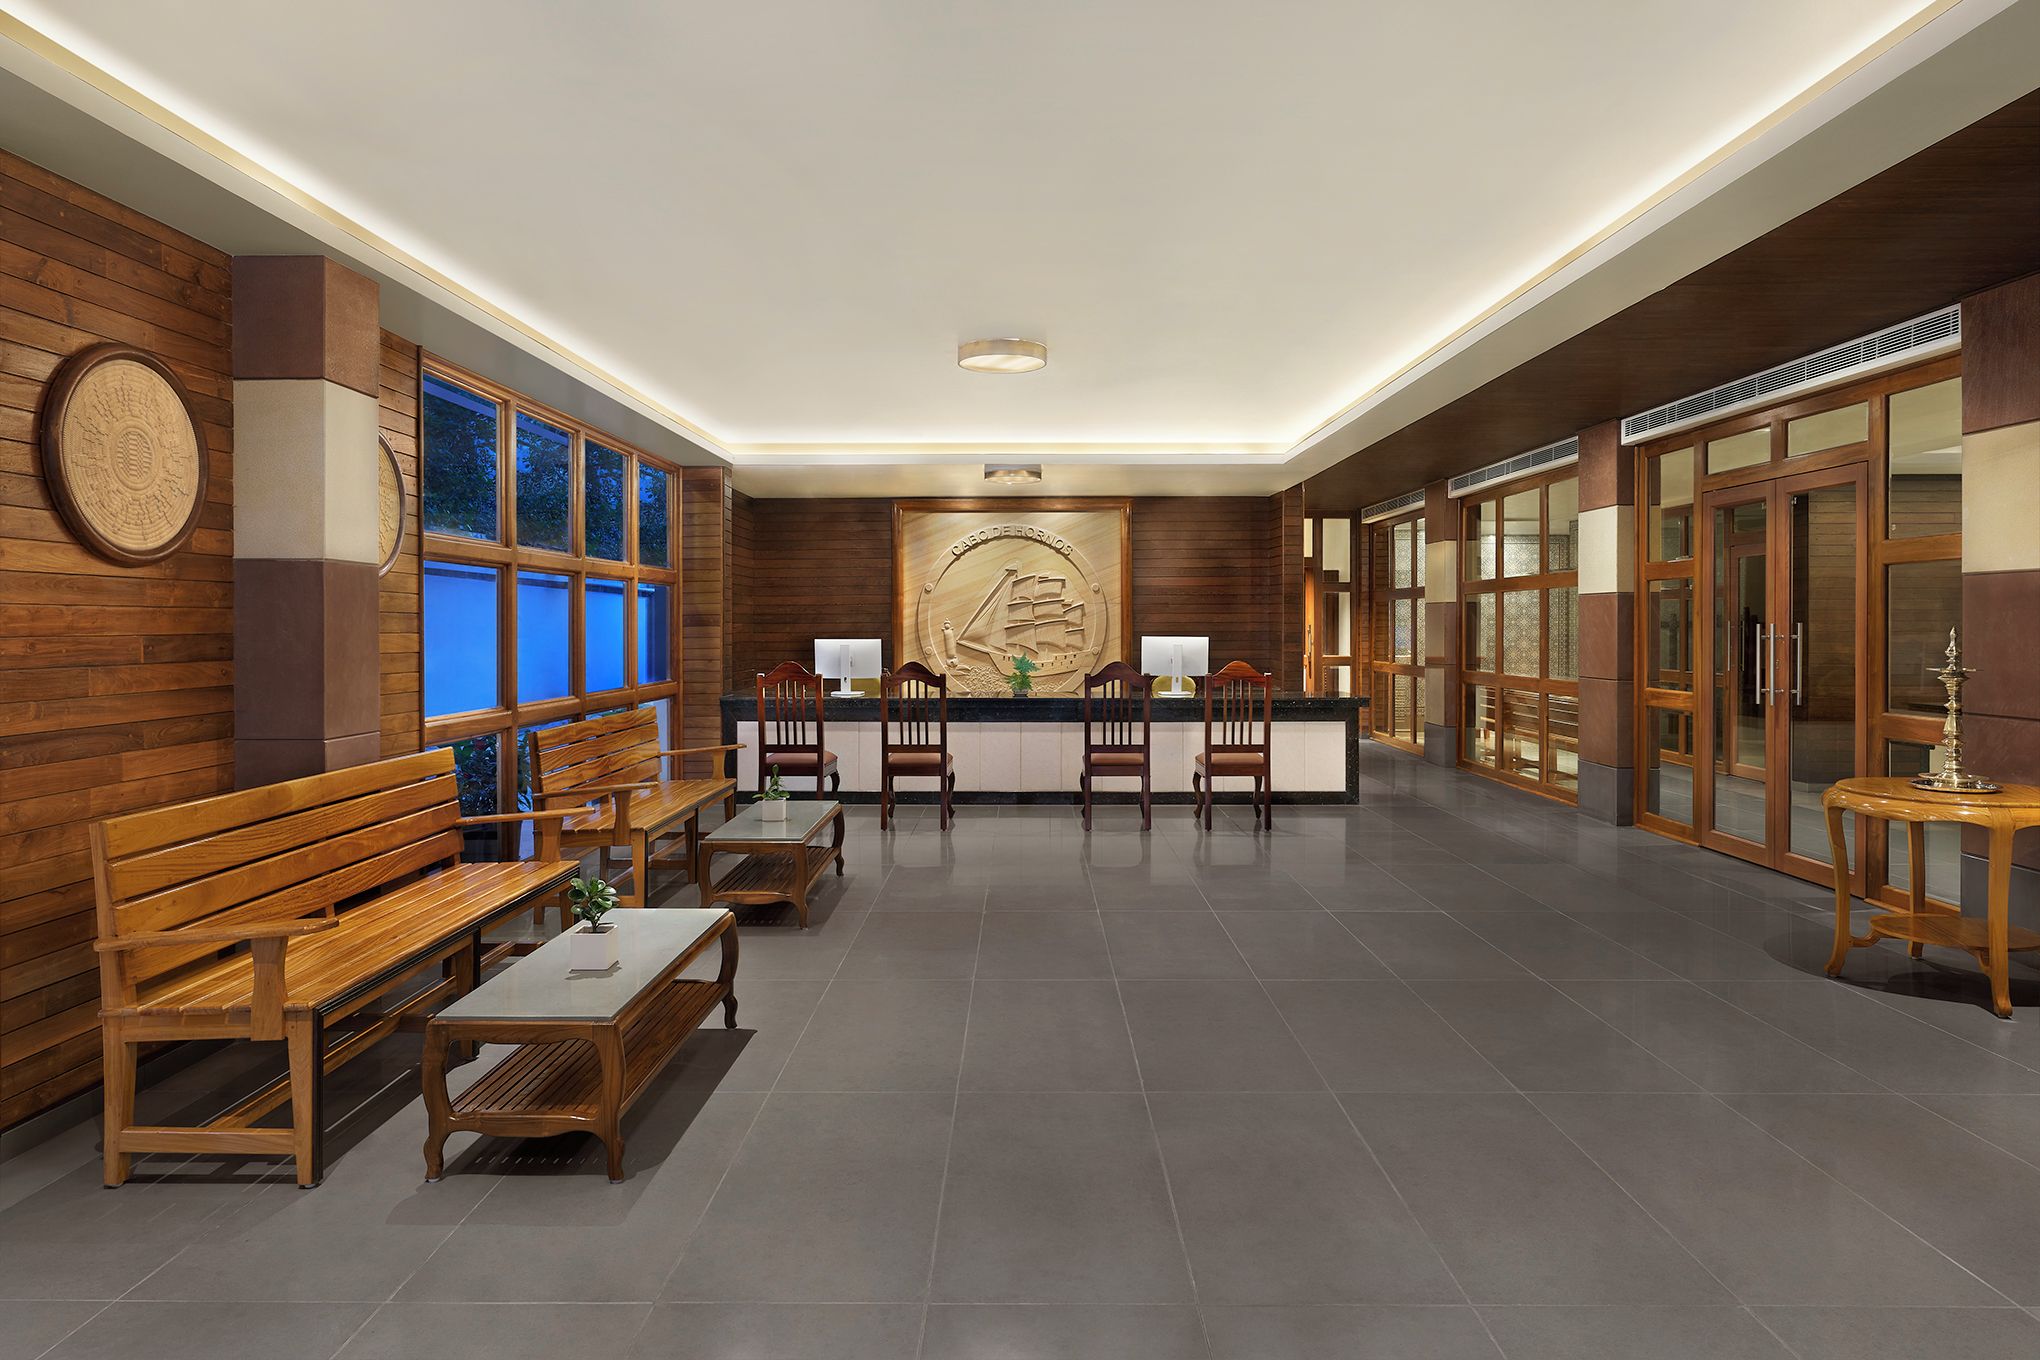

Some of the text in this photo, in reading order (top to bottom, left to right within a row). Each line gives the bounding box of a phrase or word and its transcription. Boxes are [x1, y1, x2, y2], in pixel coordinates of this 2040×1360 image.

[951, 525, 1073, 556] CABO DE HORNOS
